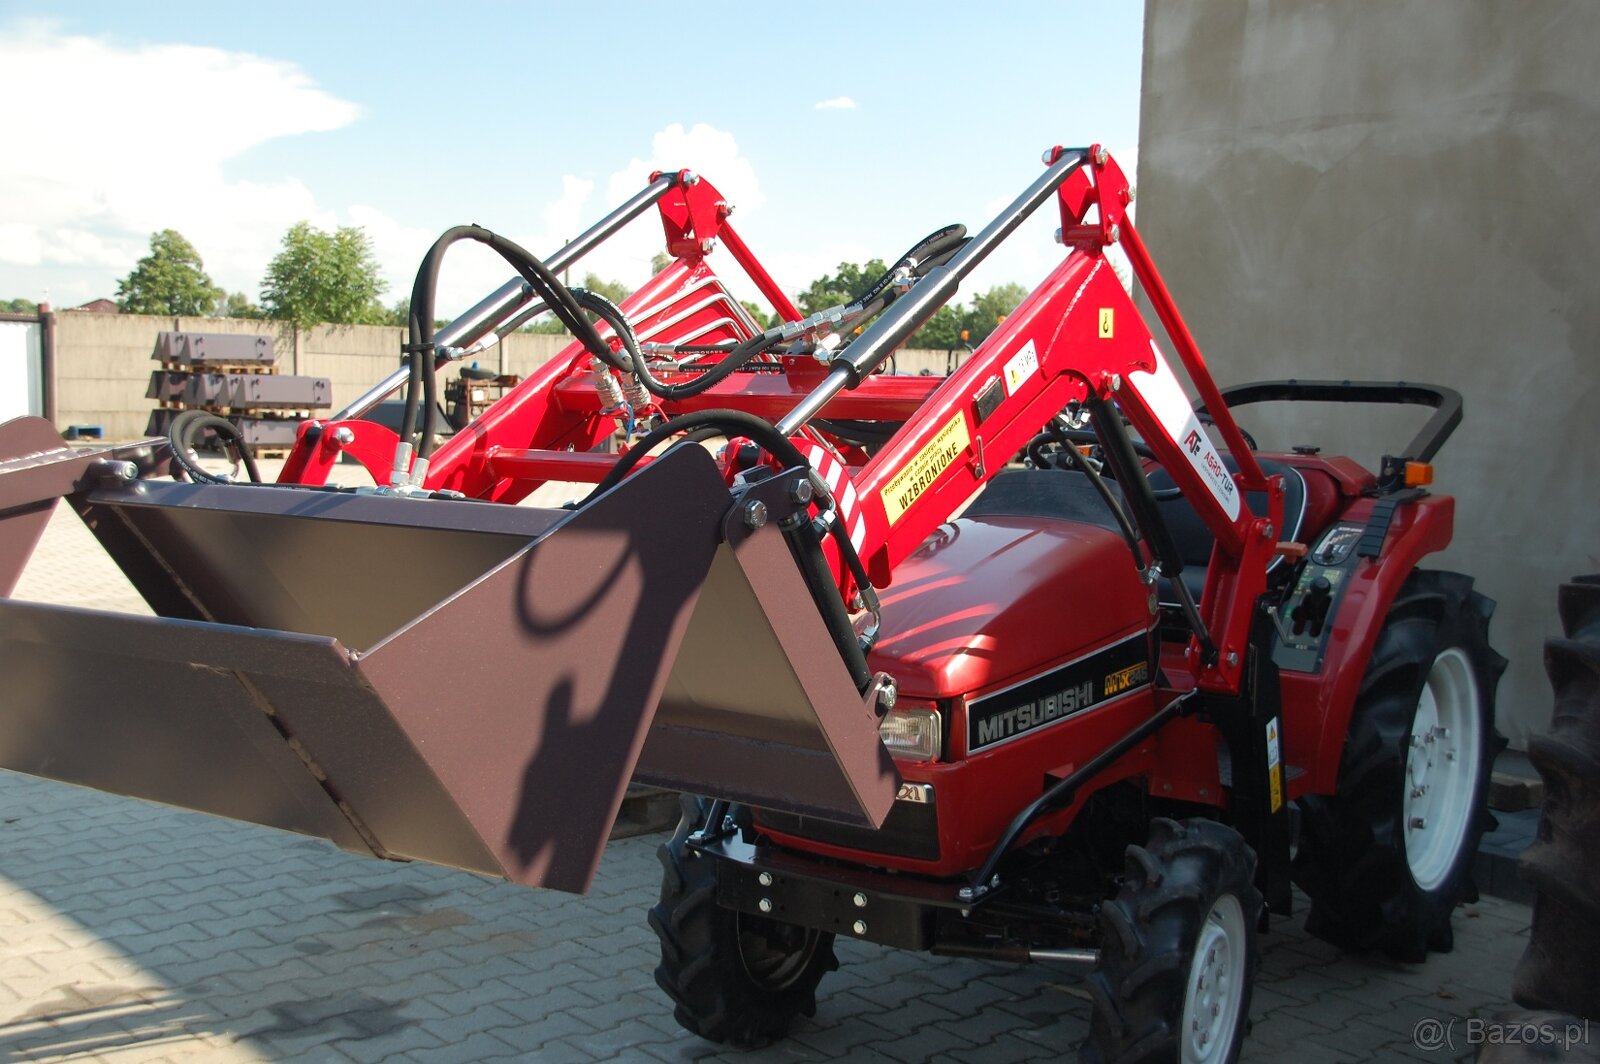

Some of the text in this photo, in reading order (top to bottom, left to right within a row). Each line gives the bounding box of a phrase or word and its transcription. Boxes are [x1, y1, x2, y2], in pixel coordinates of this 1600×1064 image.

[899, 442, 958, 510] WZBRONIONE
[1204, 451, 1234, 496] AGRO-TUR
[978, 680, 1093, 744] MITSUBISHI
